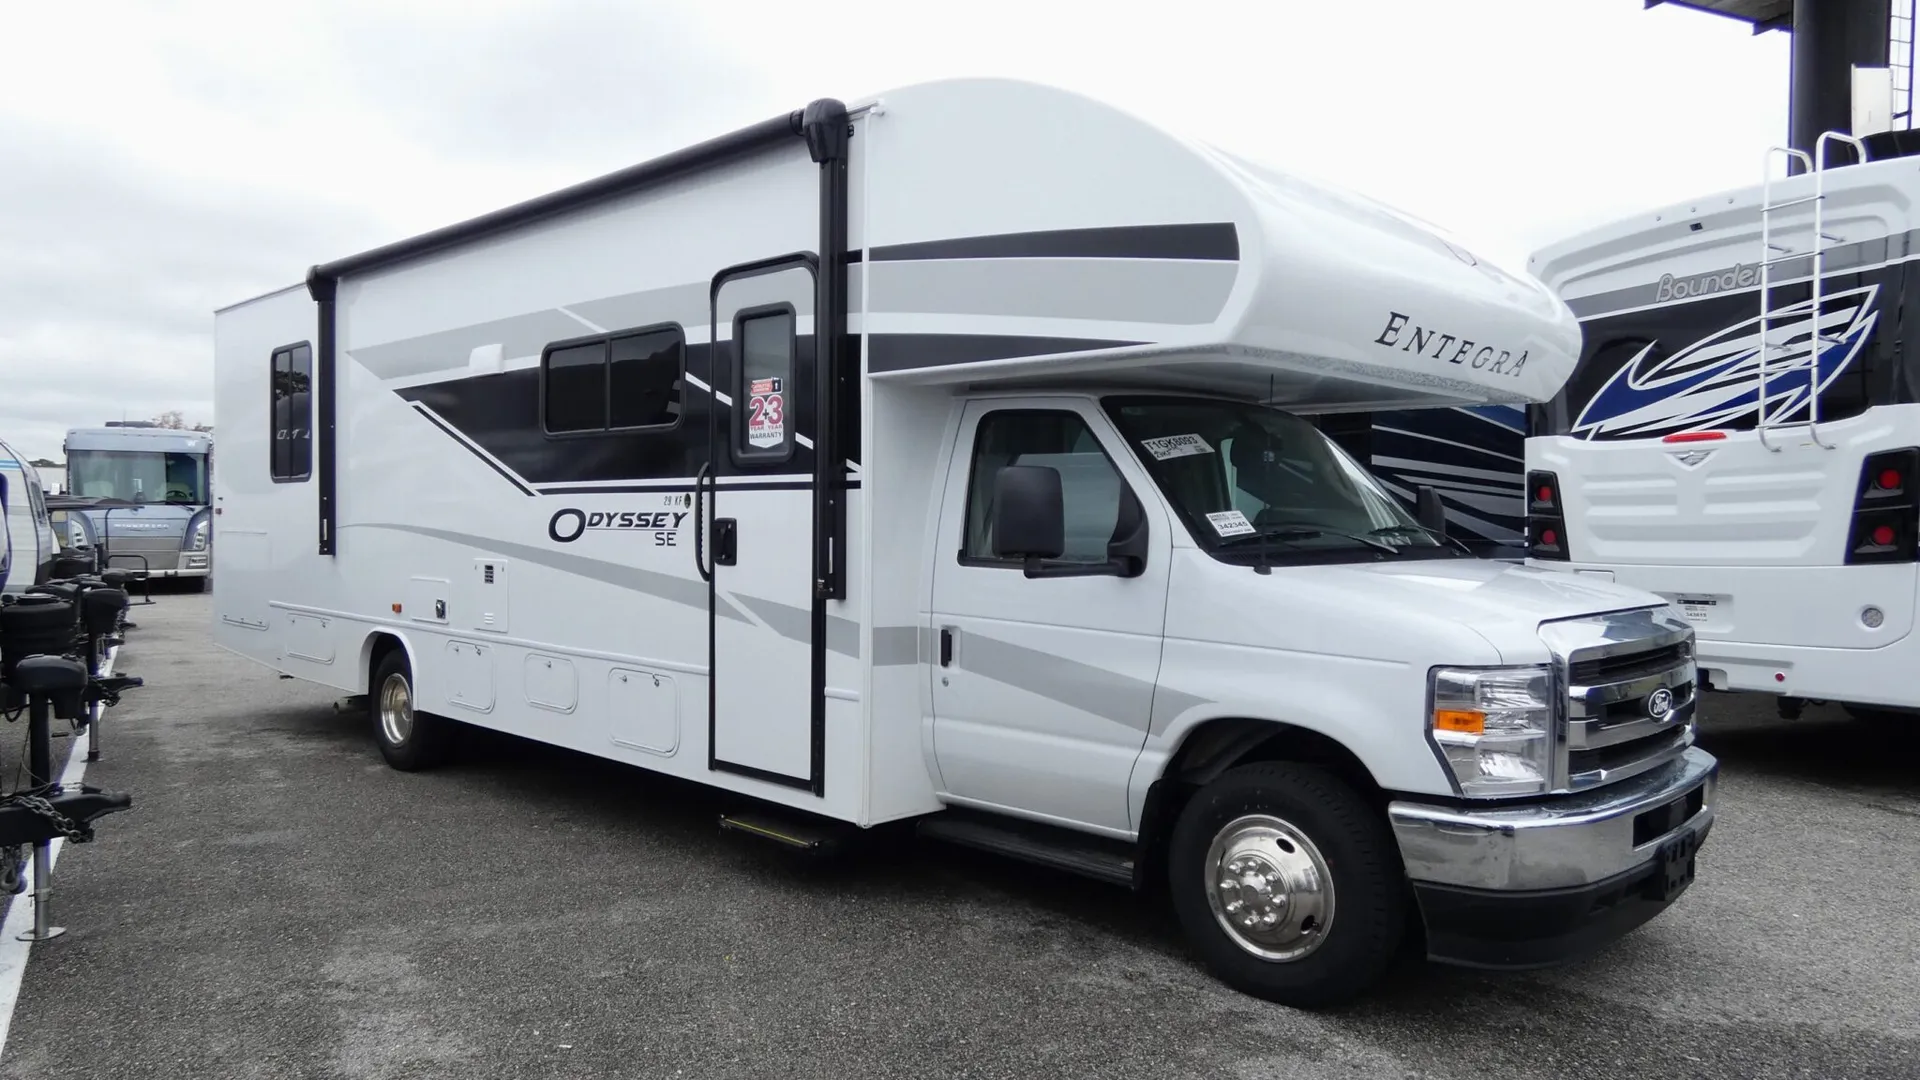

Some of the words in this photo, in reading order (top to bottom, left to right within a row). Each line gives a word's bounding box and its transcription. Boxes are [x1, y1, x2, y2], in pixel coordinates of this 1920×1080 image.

[1655, 263, 1775, 302] Bounder
[1374, 311, 1529, 377] ENTEGRA
[750, 431, 783, 440] WARRANTY
[548, 508, 689, 543] ODYSSEY
[655, 532, 677, 546] SE
